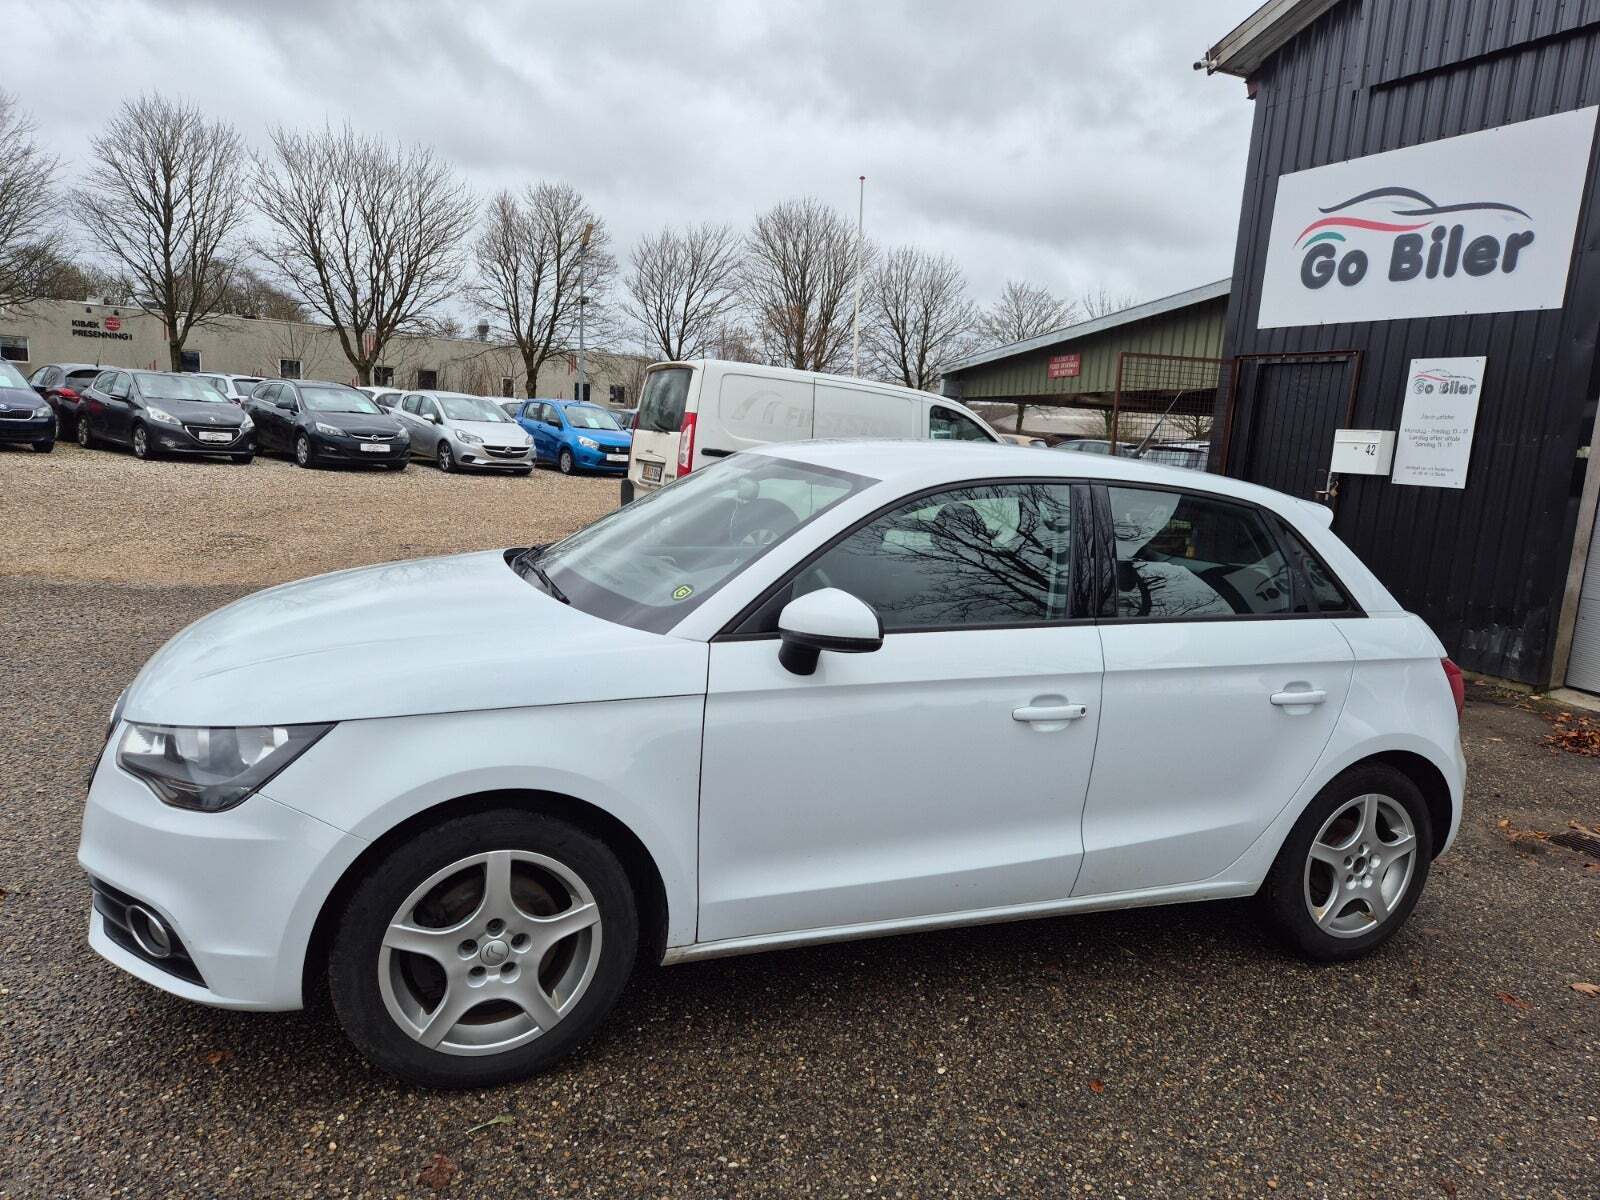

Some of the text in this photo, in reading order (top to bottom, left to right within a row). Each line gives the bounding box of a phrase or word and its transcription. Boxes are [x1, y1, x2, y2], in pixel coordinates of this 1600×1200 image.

[1300, 224, 1535, 290] Go Biler
[71, 319, 100, 329] KIBÆK
[1413, 380, 1477, 395] Go Biler
[1365, 444, 1376, 456] 42
